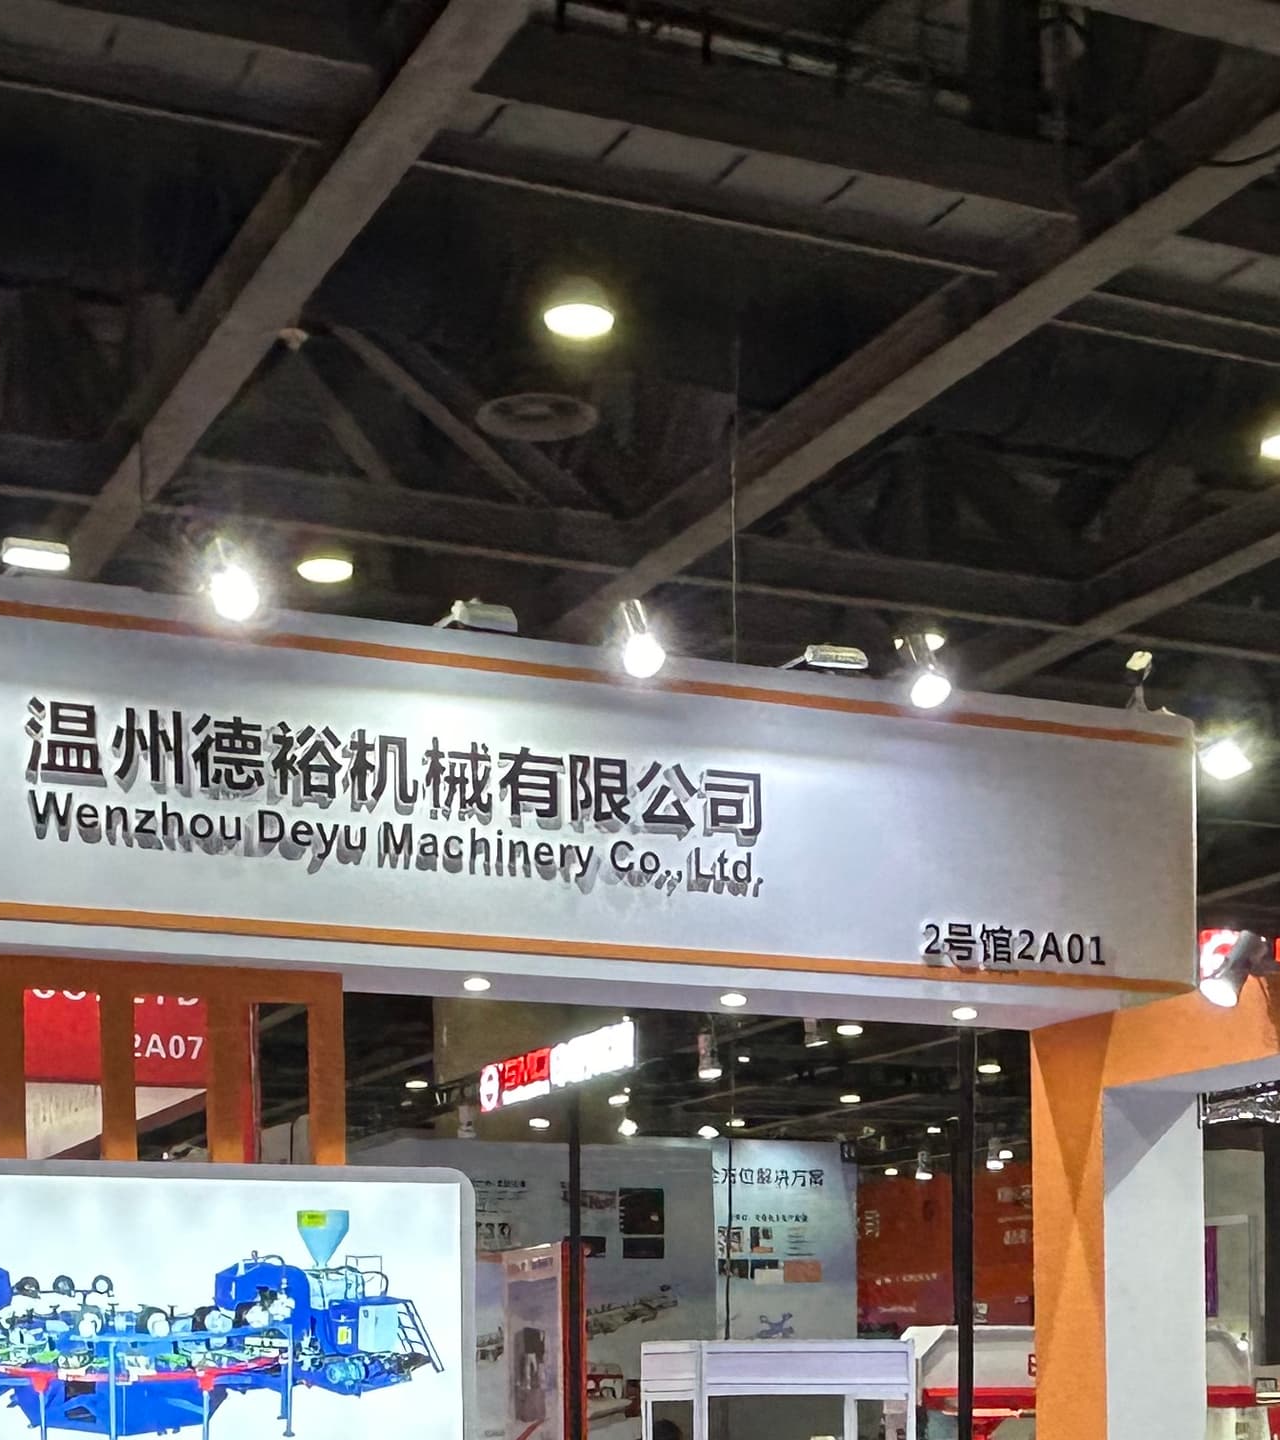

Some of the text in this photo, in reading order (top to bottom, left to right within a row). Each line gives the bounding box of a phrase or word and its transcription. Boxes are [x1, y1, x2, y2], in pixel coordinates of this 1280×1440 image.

[25, 696, 763, 840] 温州德裕机械有限公司
[27, 789, 243, 848] Wenzhou
[257, 808, 367, 862] Deyu
[381, 821, 595, 880] Machinery
[692, 846, 764, 894] Ltd.
[922, 921, 1107, 968] 2号馆2A01
